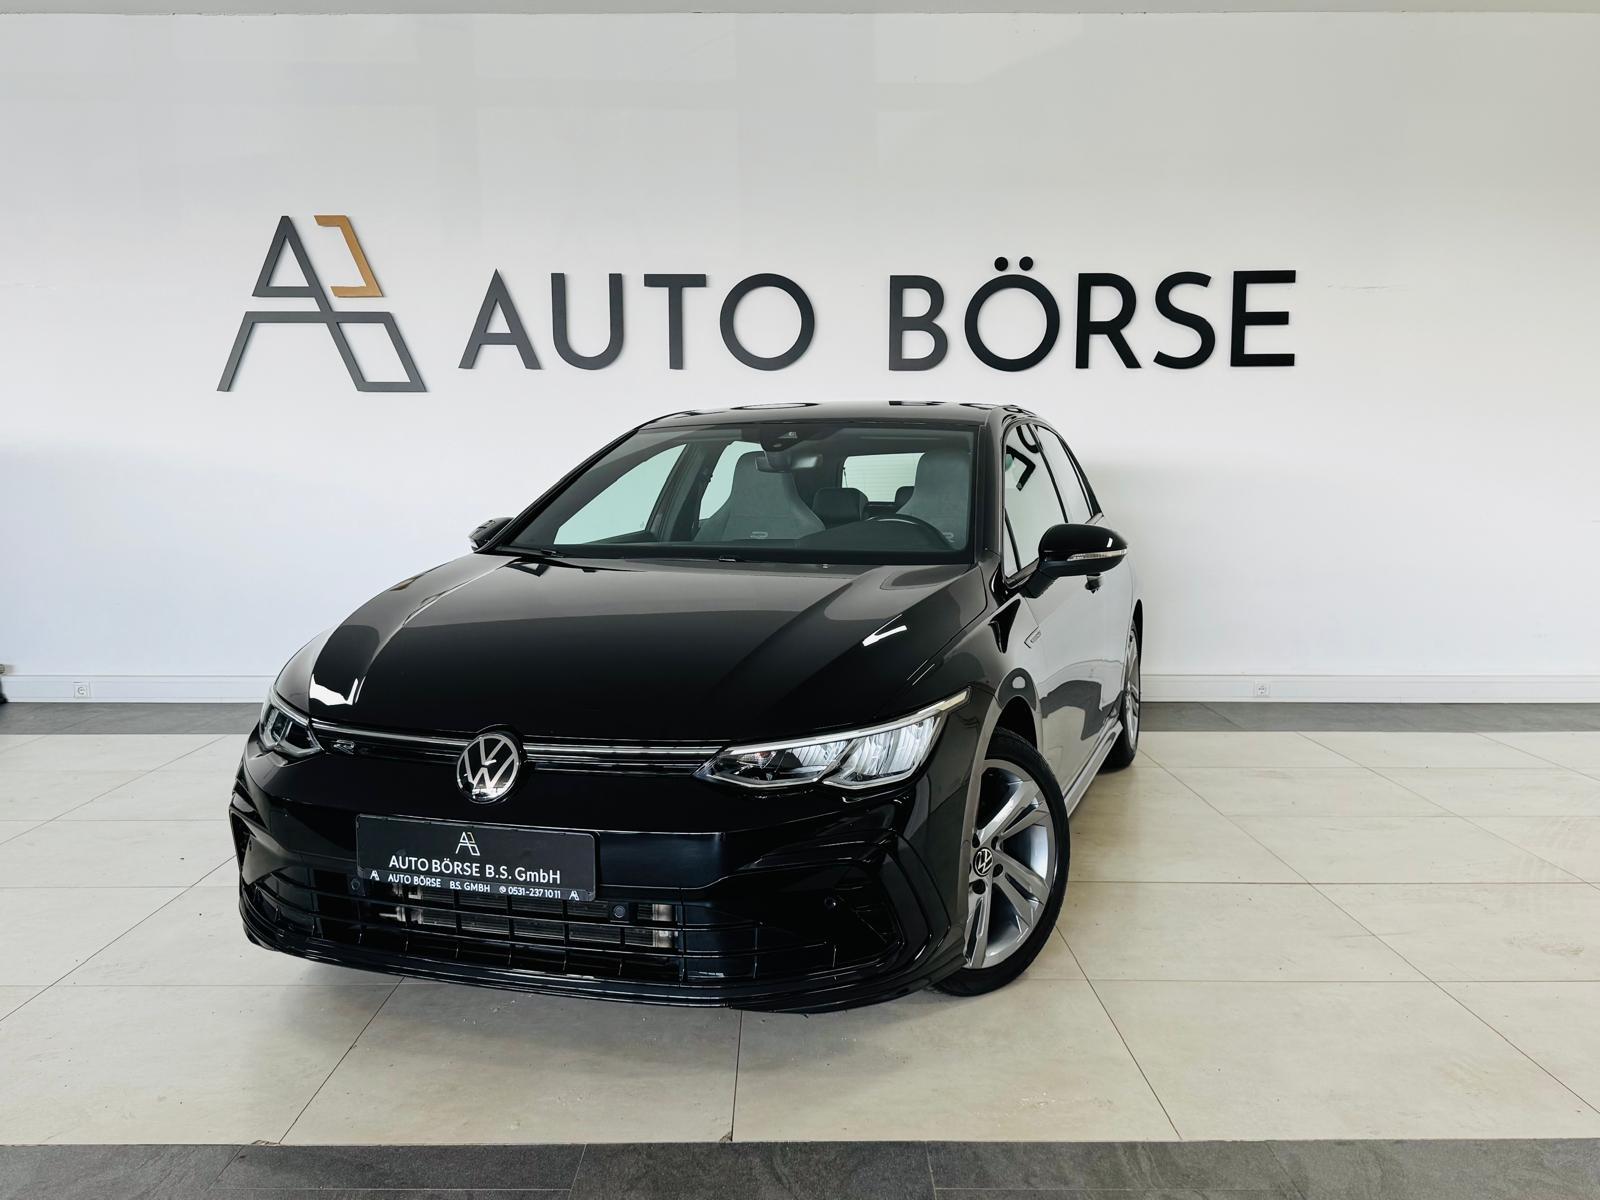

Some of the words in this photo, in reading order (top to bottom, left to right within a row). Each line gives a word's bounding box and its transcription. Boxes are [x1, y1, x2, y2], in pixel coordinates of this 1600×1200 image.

[458, 268, 816, 372] AUTO
[888, 256, 1297, 373] BÖRSE
[387, 873, 412, 885] AUTO
[413, 874, 442, 888] BÖRSE
[463, 882, 491, 893] GMBH
[388, 855, 429, 872] AUTO
[431, 857, 481, 877] BÖRSE
[484, 864, 512, 880] B.S.
[514, 867, 561, 885] GmbH
